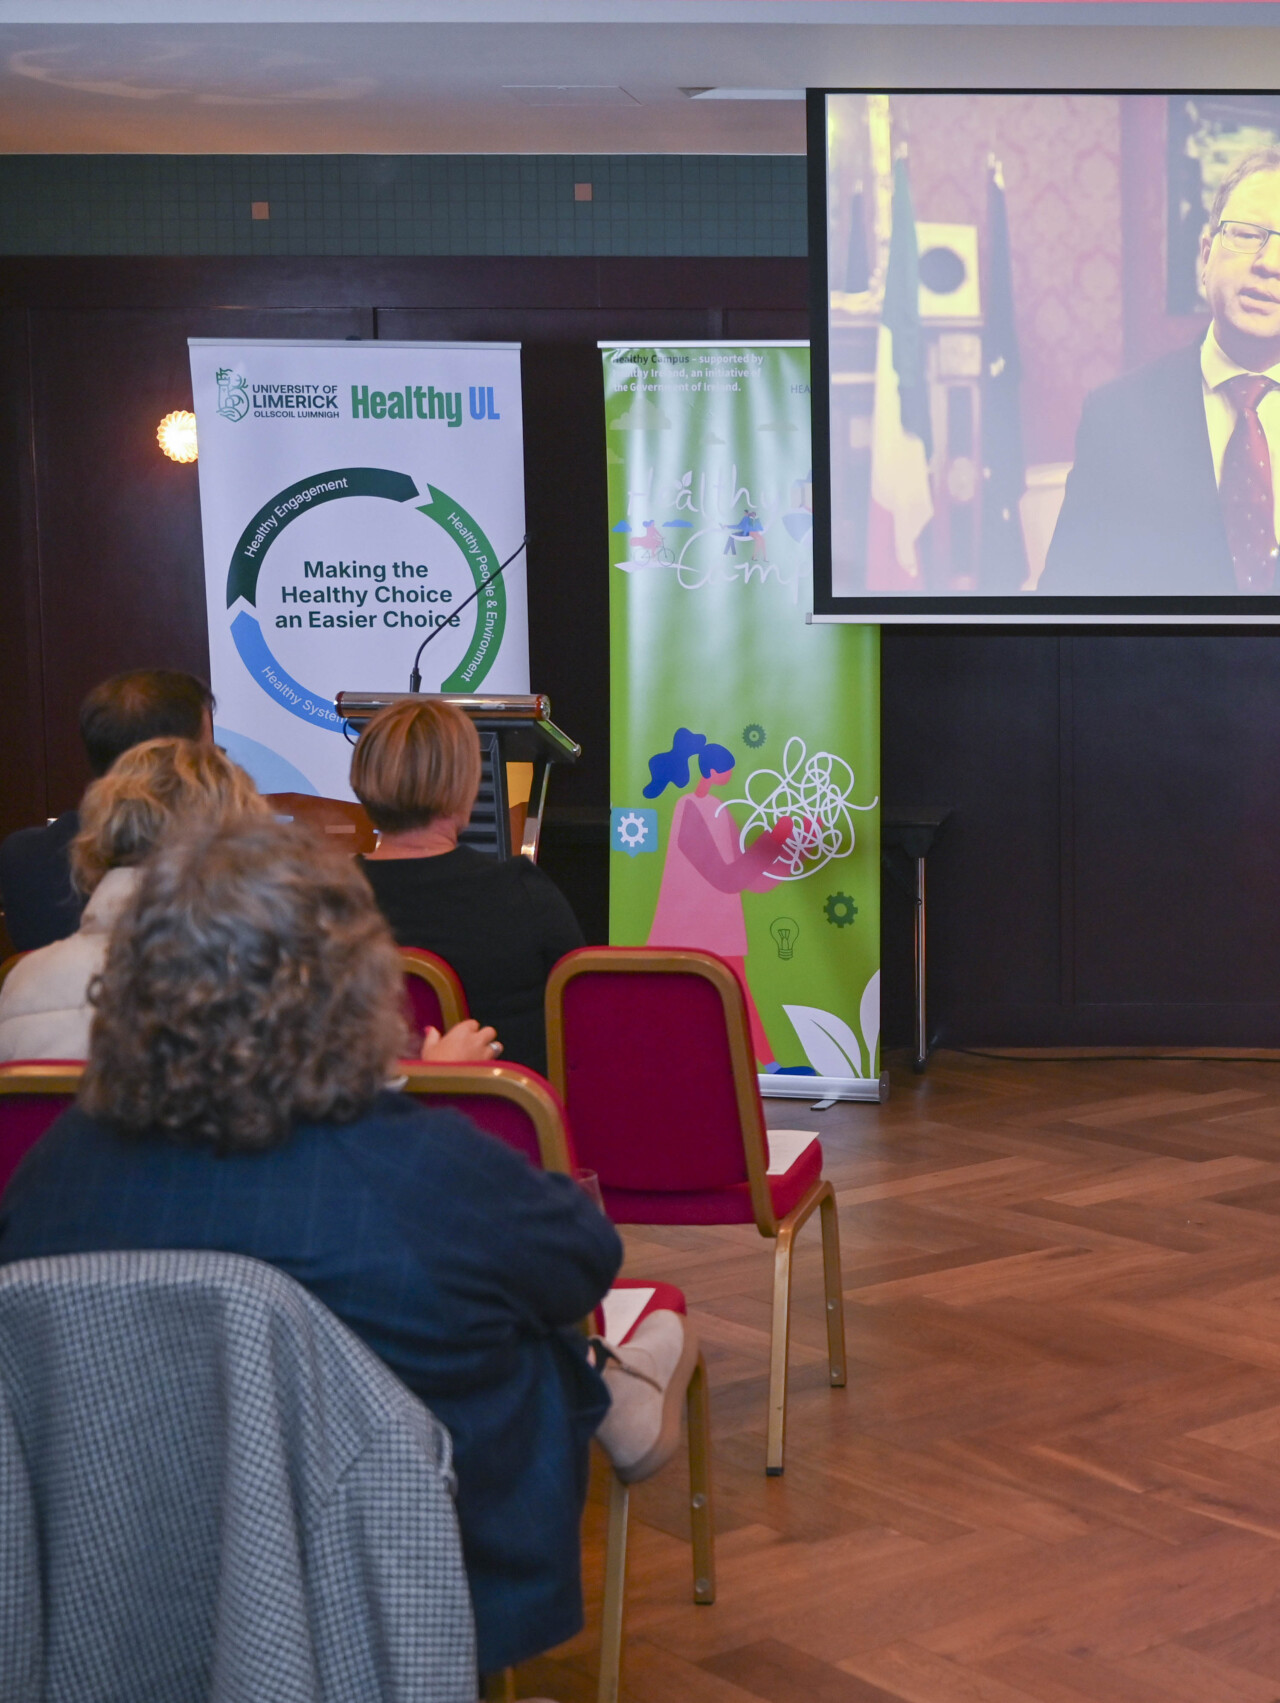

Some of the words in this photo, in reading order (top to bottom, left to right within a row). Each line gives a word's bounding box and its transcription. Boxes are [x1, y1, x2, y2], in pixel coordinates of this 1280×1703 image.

[651, 354, 690, 366] Campus
[699, 354, 749, 365] supported
[750, 354, 763, 365] by
[613, 369, 648, 380] lthy
[651, 369, 689, 379] Irend,
[691, 370, 702, 378] an
[705, 368, 749, 378] initiative
[252, 384, 320, 394] UNIVERSITY
[322, 385, 338, 394] OF
[613, 383, 628, 392] the
[630, 382, 688, 392] Governnt
[691, 382, 702, 392] of
[791, 384, 811, 394] HEA
[253, 395, 339, 410] LIMERICK
[351, 385, 463, 428] Healthy
[469, 386, 501, 420] UL
[253, 410, 296, 419] OLLSCOIL
[297, 410, 340, 419] LUIMNIGH
[244, 516, 278, 558] Healthy
[274, 477, 348, 518] Engagement
[447, 512, 481, 555] Healthy
[303, 560, 387, 582] Making
[392, 561, 429, 579] the
[475, 555, 495, 598] People
[677, 528, 814, 605] Camp
[281, 585, 368, 608] Healthy
[375, 585, 453, 604] Choice
[487, 600, 498, 609] &
[275, 613, 303, 629] an
[309, 610, 377, 628] Easier
[383, 610, 461, 628] Choice
[460, 611, 498, 683] Environment
[261, 666, 302, 707] Healthy
[302, 699, 349, 724] System
